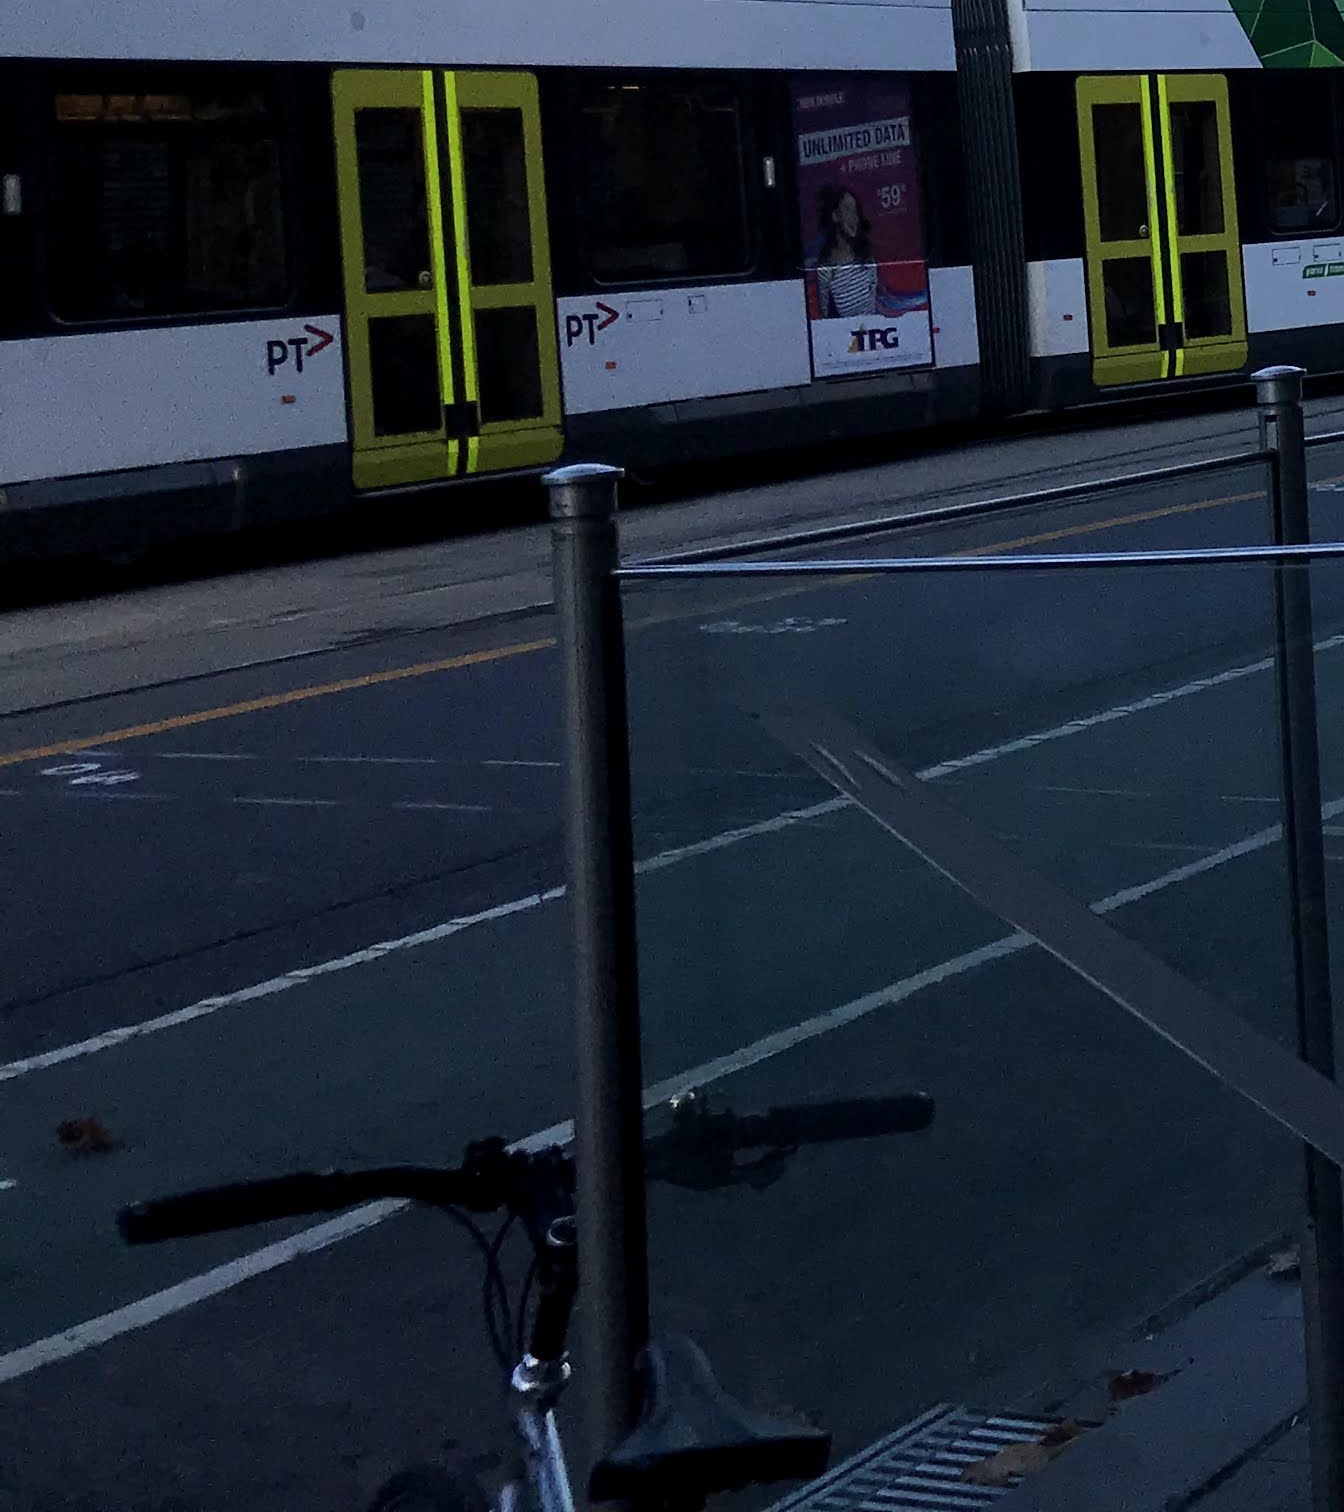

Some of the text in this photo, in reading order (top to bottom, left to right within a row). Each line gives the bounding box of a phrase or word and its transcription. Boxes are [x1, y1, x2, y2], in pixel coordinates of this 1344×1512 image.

[803, 123, 906, 159] UNLIMITED DATA
[849, 326, 899, 352] TPG
